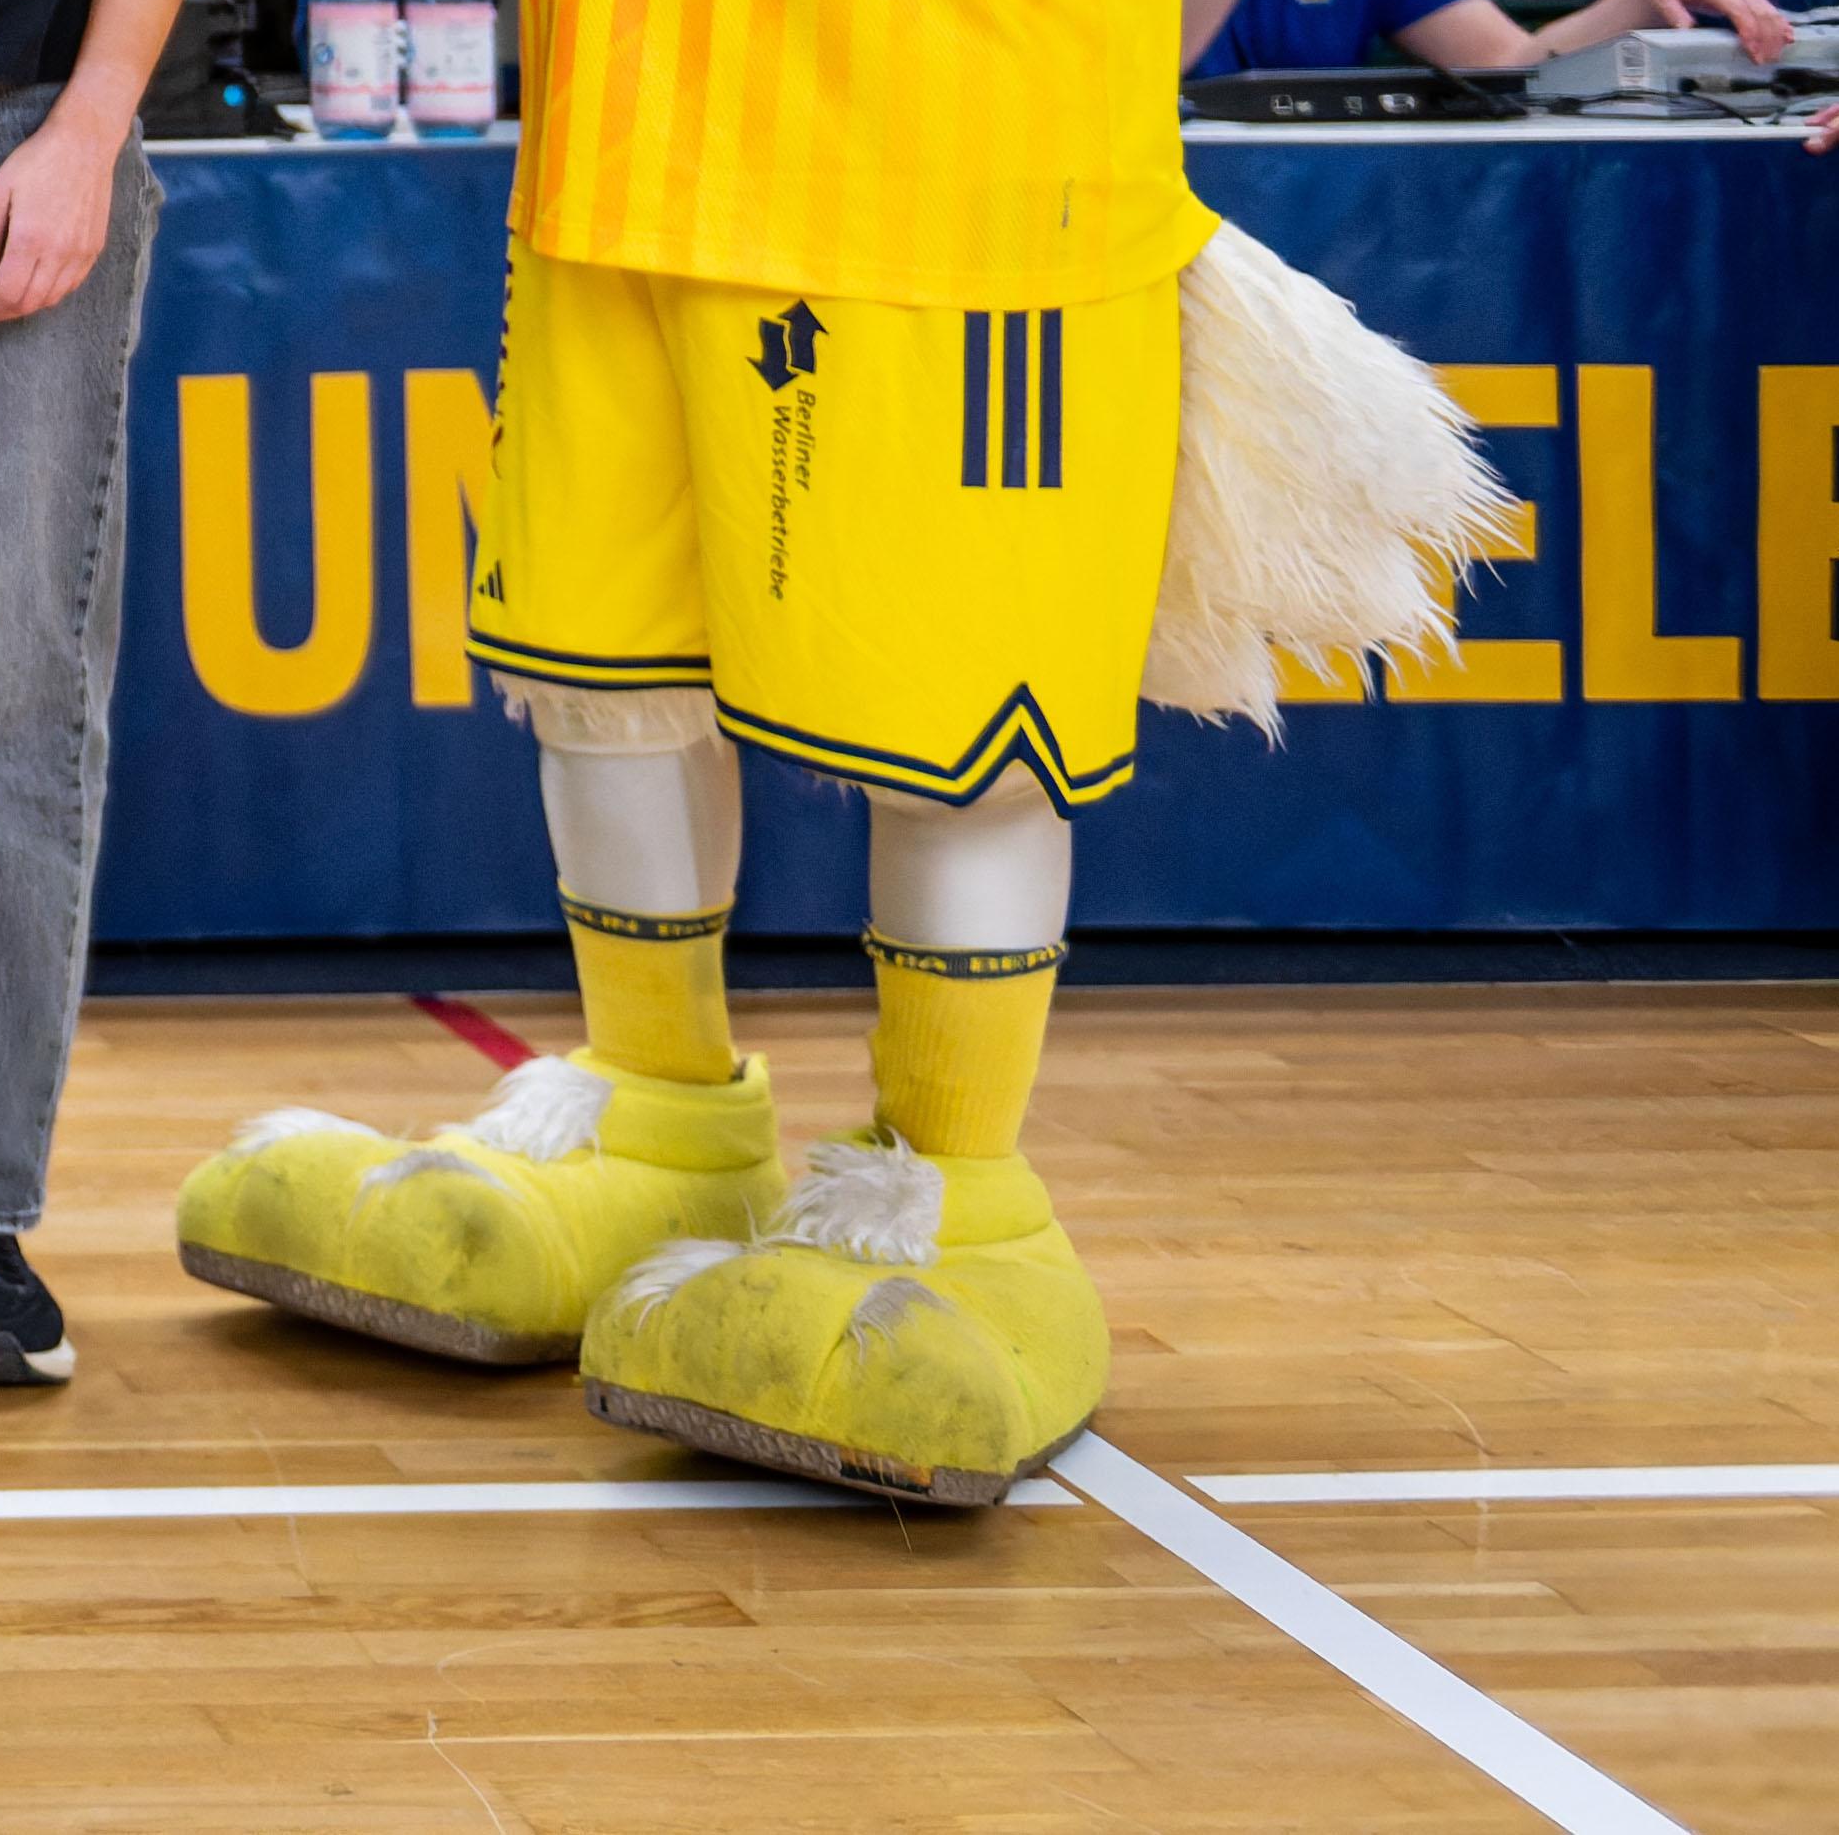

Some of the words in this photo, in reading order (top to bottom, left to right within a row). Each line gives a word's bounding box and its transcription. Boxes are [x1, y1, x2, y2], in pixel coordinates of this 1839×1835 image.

[769, 405, 792, 601] Wasserbetriebe
[794, 388, 816, 492] Berliner
[178, 368, 495, 718] UN
